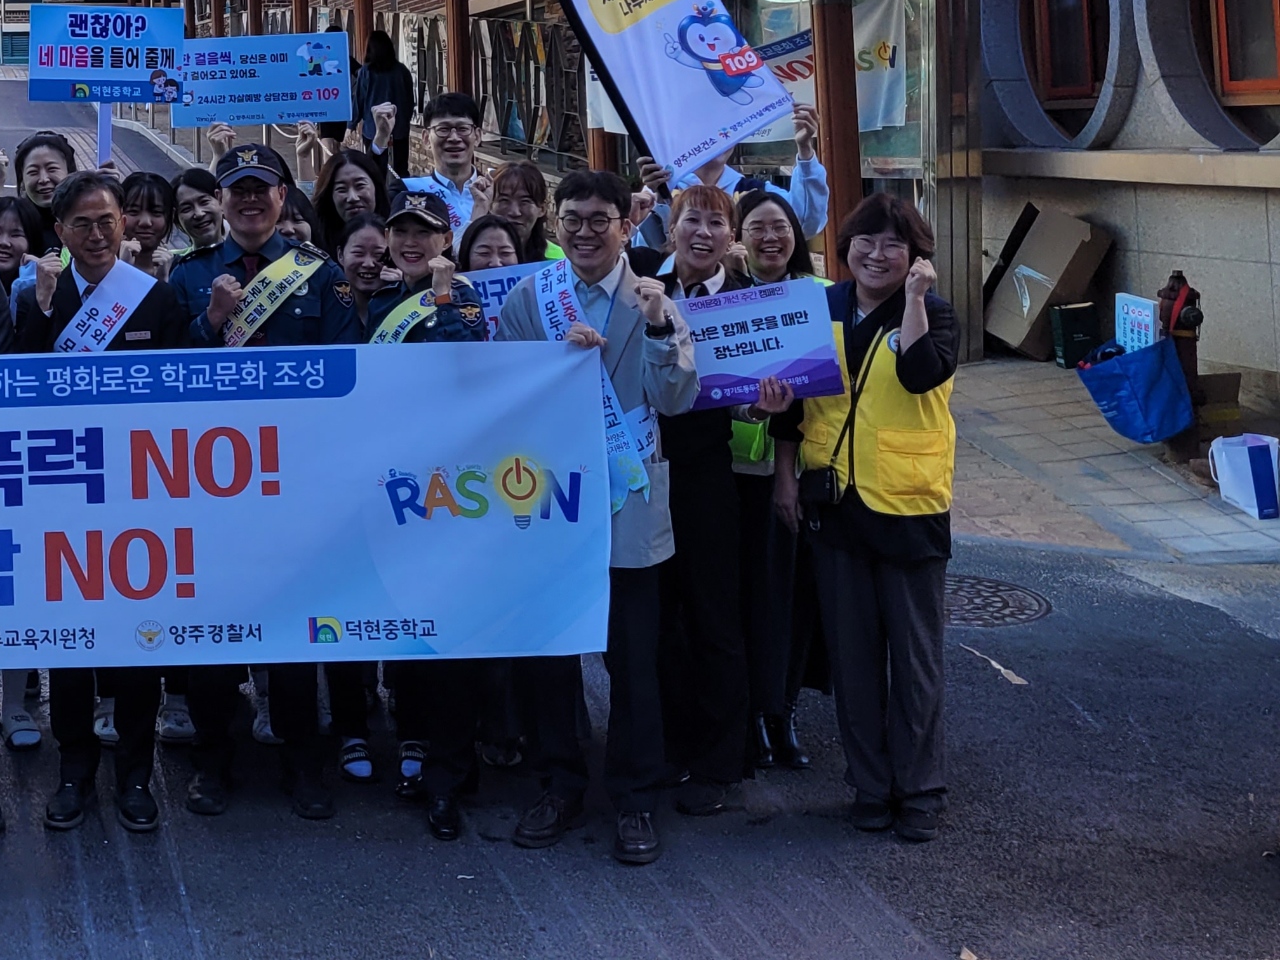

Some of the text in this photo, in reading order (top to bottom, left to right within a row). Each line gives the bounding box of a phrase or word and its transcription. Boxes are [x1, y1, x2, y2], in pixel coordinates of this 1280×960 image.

[68, 13, 147, 38] 괜찮아?
[38, 45, 175, 69] 네 마음을 들어 줄께
[194, 51, 288, 67] 걸음씩, 당신은 이미
[725, 50, 758, 71] 109
[190, 70, 228, 81] 걸어오고
[230, 69, 260, 80] 있어요.
[92, 85, 142, 98] 덕현중학교
[197, 87, 340, 105] 24시간 자살예방 상담전화 109
[539, 268, 554, 294] 우리
[555, 259, 568, 285] 려와
[266, 269, 303, 305] 학교폭력
[688, 286, 784, 312] 언어문화 개선 주간 캠페인
[75, 307, 100, 338] 우리
[90, 302, 128, 346] 배려와
[721, 320, 750, 337] 함께
[751, 315, 779, 332] 웃을
[780, 310, 809, 327] 때만
[713, 337, 784, 360] 장난입니다.
[45, 363, 154, 398] 평화로운
[161, 361, 268, 394] 학교문화
[273, 358, 325, 391] 조성
[129, 425, 282, 500] NO!
[384, 454, 582, 530] RASON
[43, 526, 197, 602] NO!
[169, 622, 263, 646] 양주경찰서
[344, 618, 438, 642] 덕현중학교
